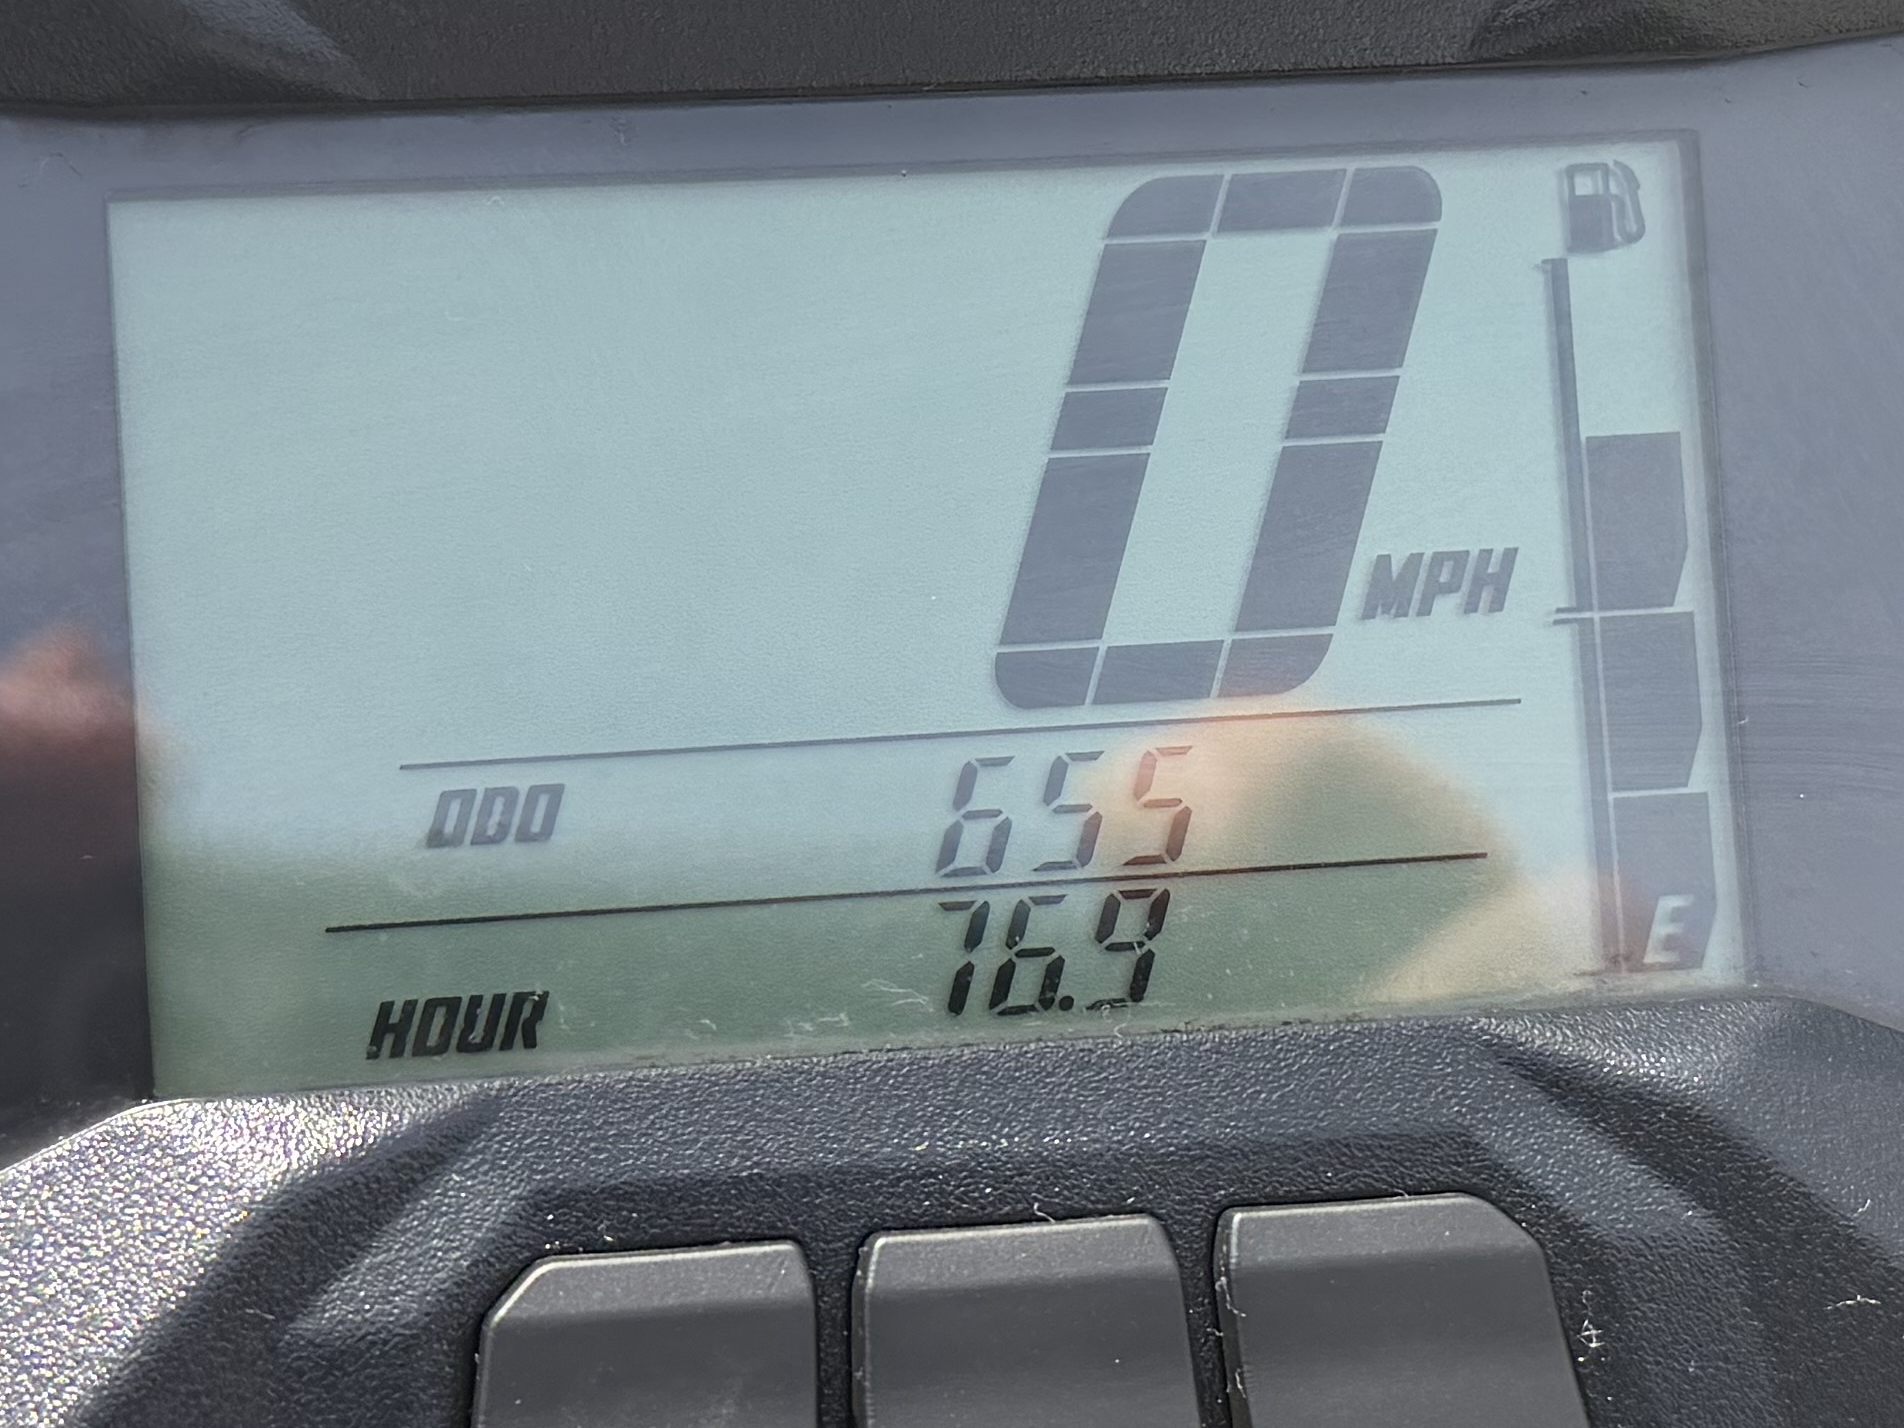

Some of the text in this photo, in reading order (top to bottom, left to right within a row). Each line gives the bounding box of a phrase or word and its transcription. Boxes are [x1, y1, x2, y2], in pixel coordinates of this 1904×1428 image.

[996, 166, 1442, 709] 0
[1361, 546, 1520, 620] MPH
[426, 744, 1194, 879] ODO 655
[366, 886, 1172, 1060] HOUR 76.9
[1643, 894, 1694, 964] E
